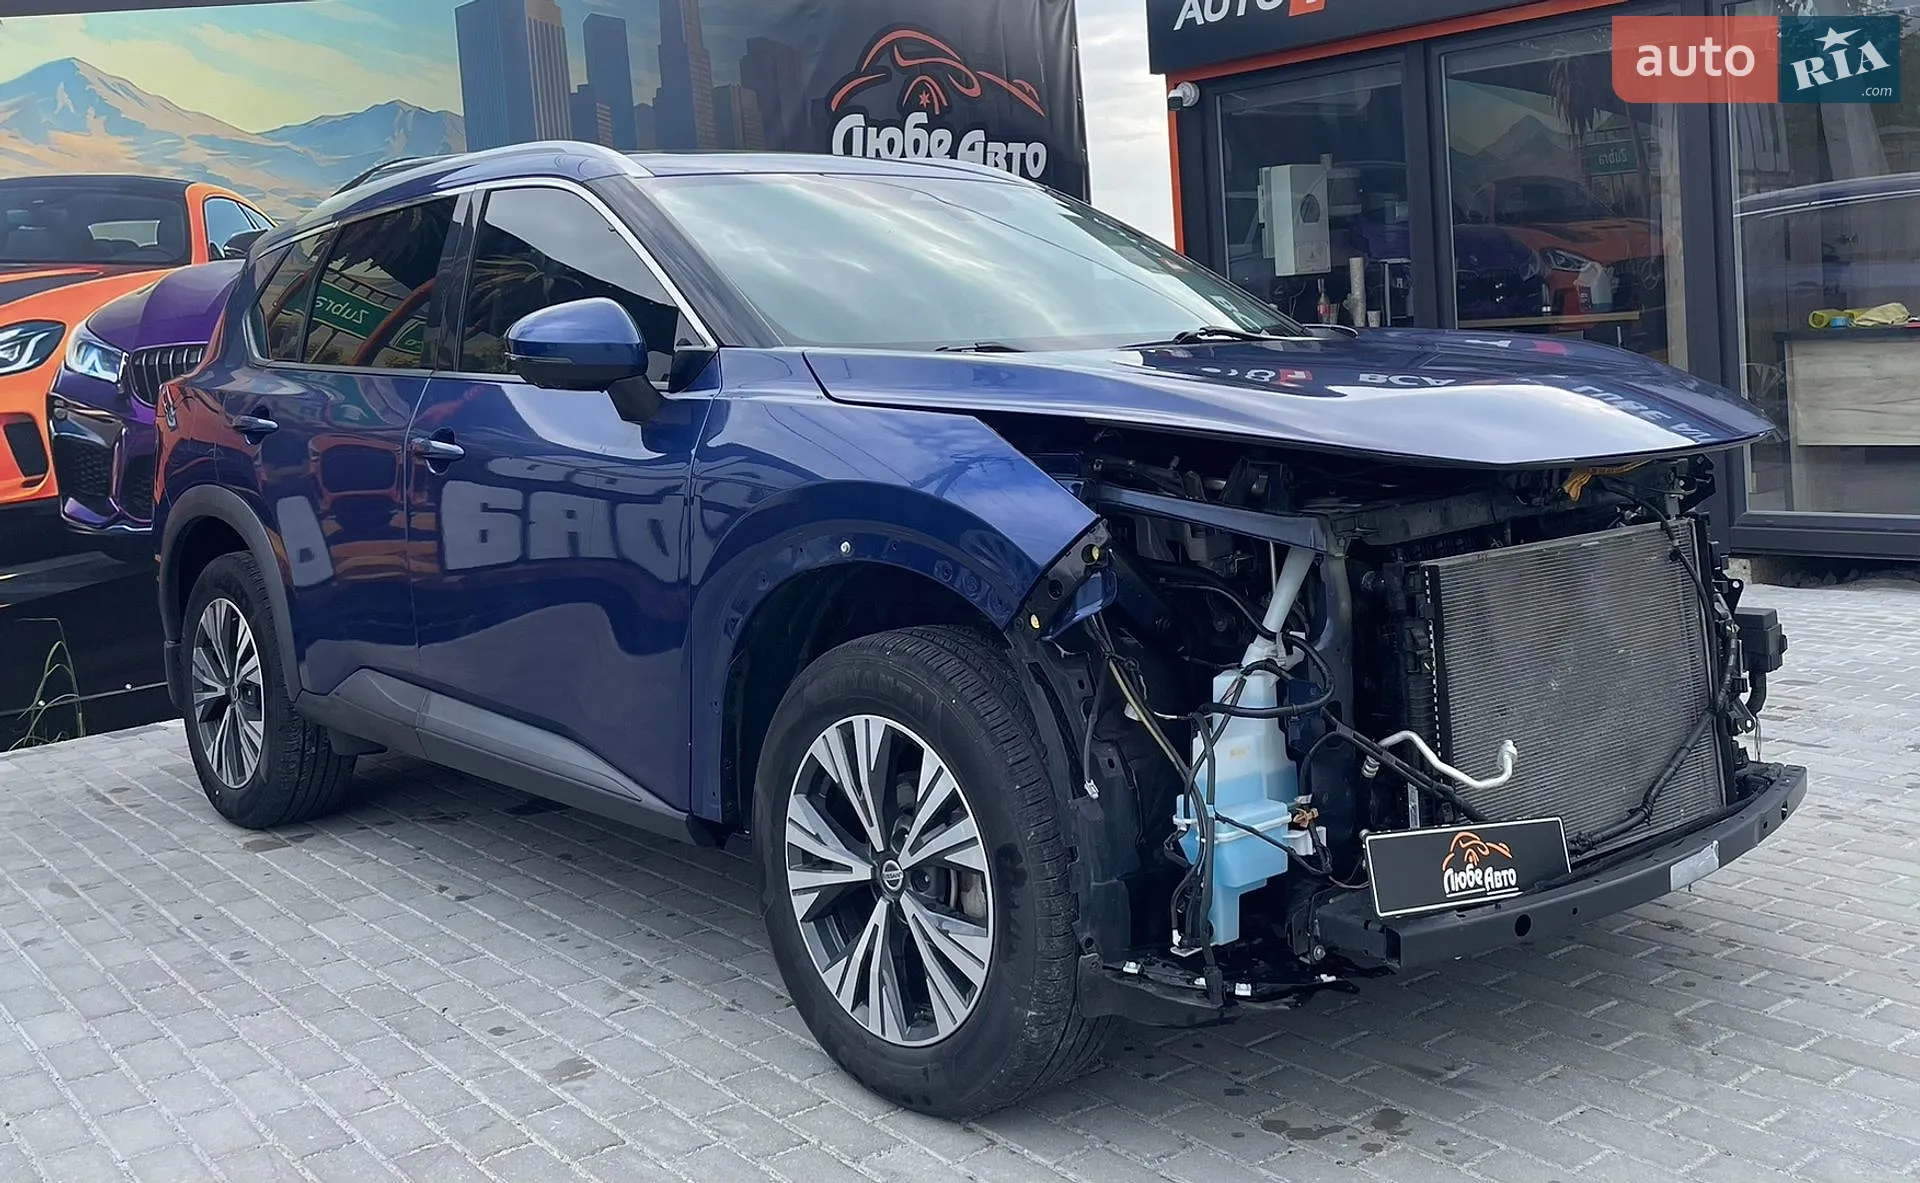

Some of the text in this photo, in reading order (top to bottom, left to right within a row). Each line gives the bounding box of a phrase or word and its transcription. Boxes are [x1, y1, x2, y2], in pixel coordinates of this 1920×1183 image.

[832, 112, 952, 159] Любе
[1443, 863, 1517, 893] Любе Авто
